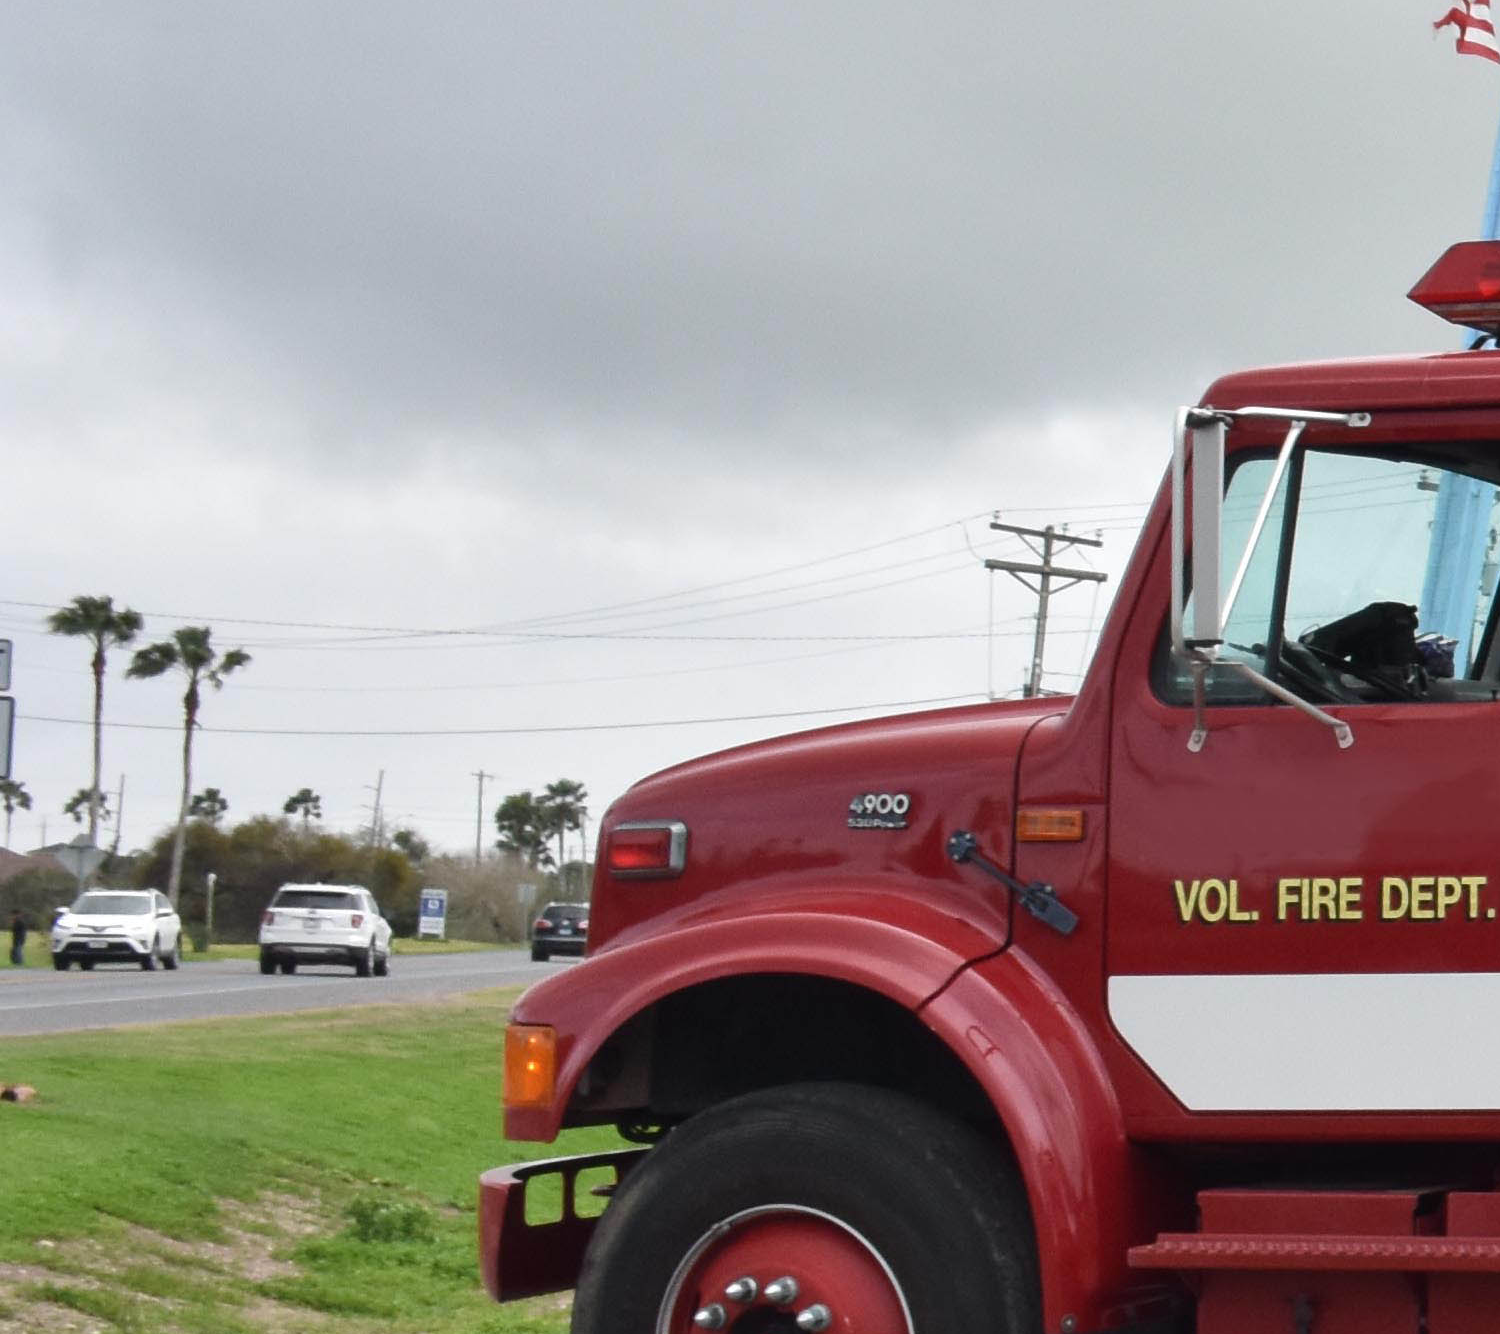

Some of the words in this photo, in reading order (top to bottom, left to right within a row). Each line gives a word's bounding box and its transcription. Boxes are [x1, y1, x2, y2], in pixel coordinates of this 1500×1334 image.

[849, 794, 909, 814] 4900
[1174, 879, 1260, 922] VOL.
[1277, 877, 1363, 921] FIRE
[1381, 876, 1497, 920] DEPT.
